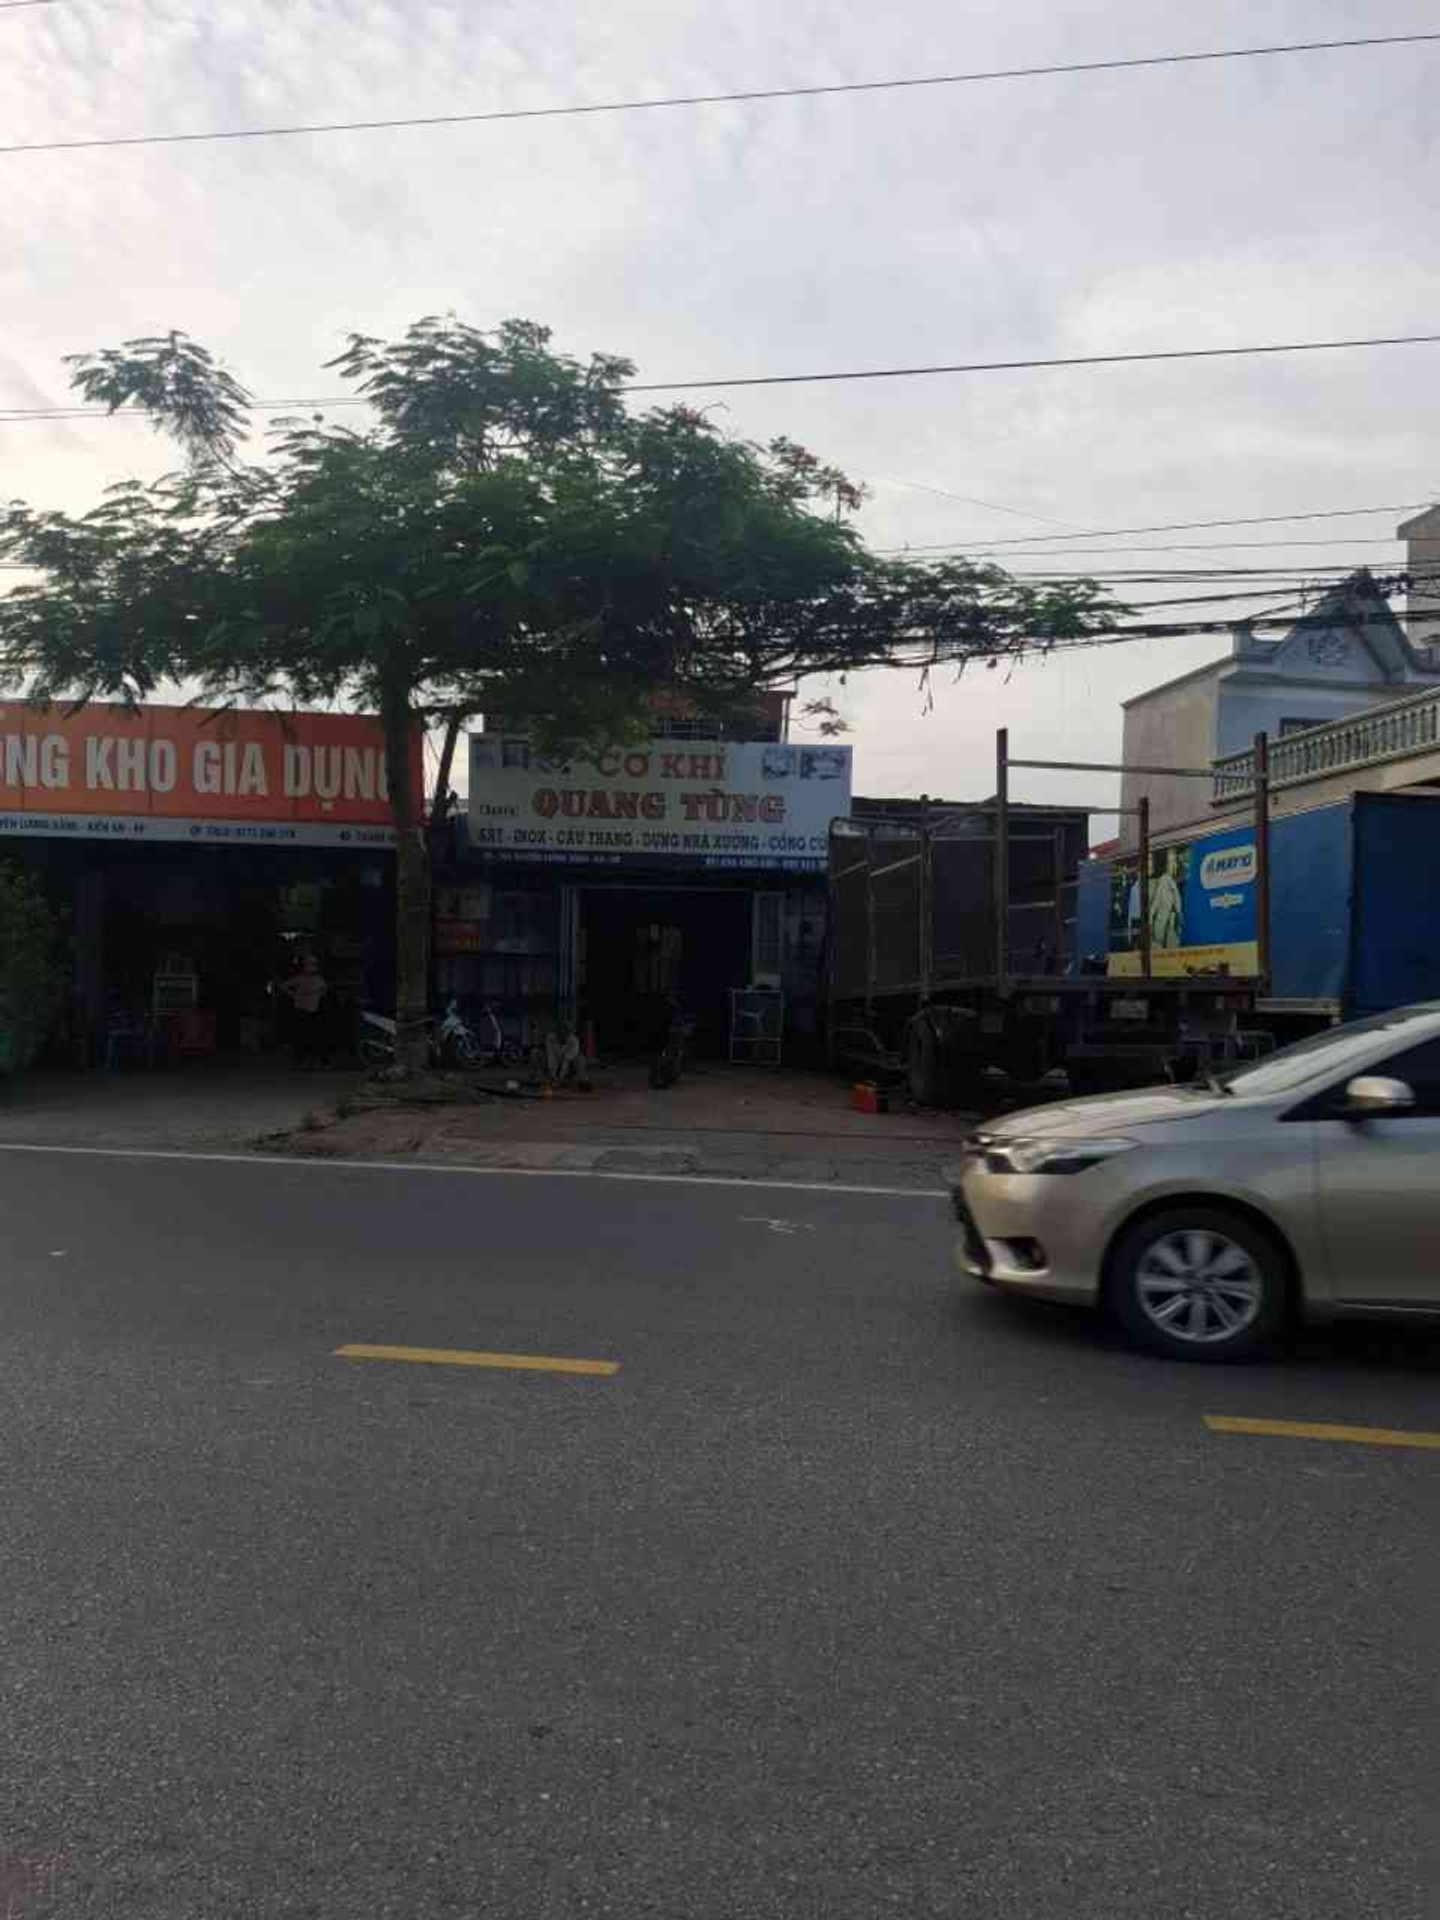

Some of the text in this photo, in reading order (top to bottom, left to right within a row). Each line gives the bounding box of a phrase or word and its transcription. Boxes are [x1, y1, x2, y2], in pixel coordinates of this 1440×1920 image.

[0, 733, 70, 789] NG
[84, 736, 178, 793] KHO
[192, 741, 268, 797] GIA
[661, 746, 727, 781] KHÍ
[533, 786, 787, 823] QUANG TÙNG
